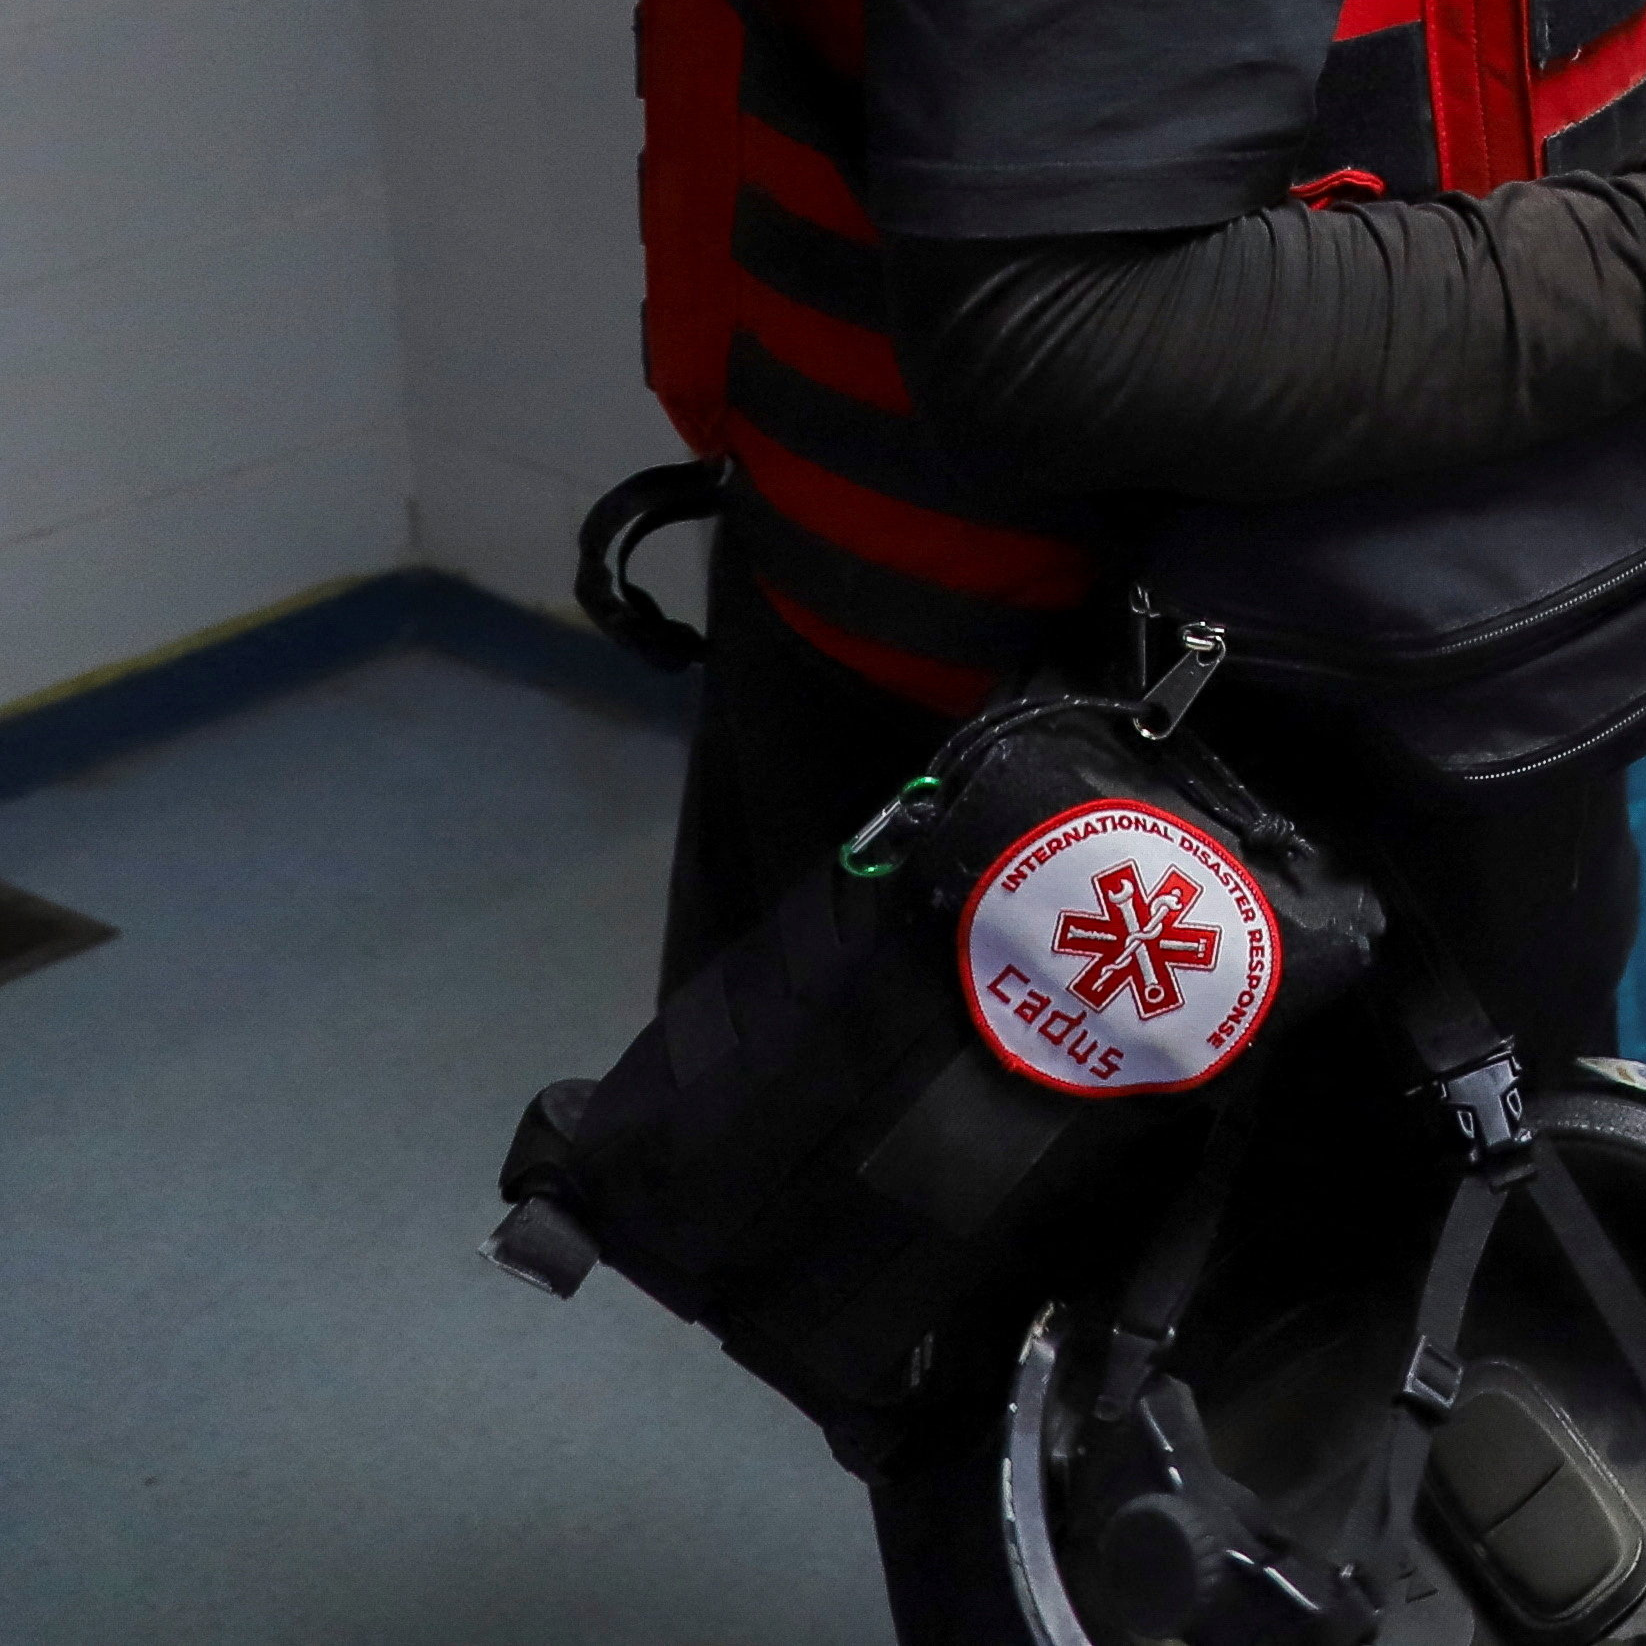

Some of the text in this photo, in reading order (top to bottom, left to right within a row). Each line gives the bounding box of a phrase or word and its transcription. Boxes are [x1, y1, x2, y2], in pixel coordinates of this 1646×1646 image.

[1001, 815, 1266, 1050] INTERNATIONAL DISASTER RESPONSE
